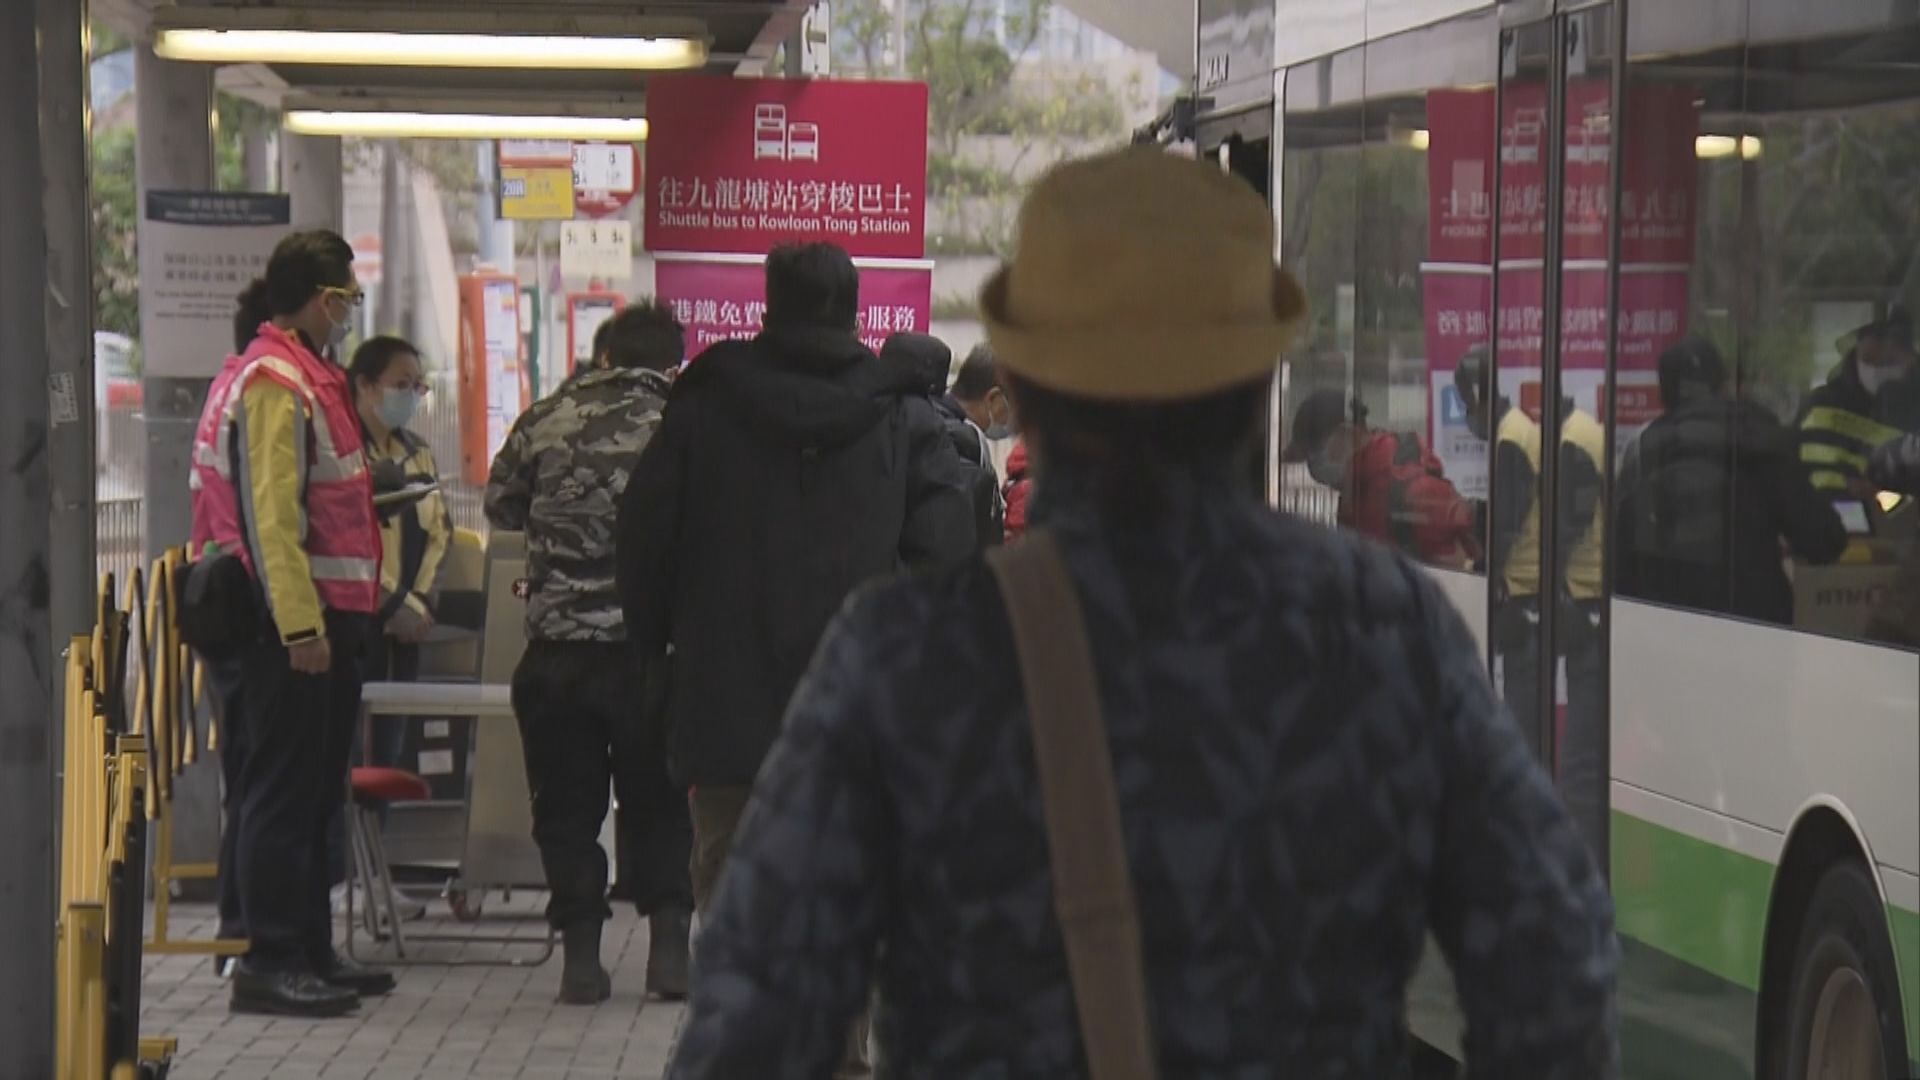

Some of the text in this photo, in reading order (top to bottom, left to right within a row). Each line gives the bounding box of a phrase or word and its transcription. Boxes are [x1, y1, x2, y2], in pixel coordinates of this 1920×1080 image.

[658, 175, 911, 214] 往九龍塘站穿梭巴士
[658, 211, 910, 235] Shuttle bus to Kowloon Tong Station
